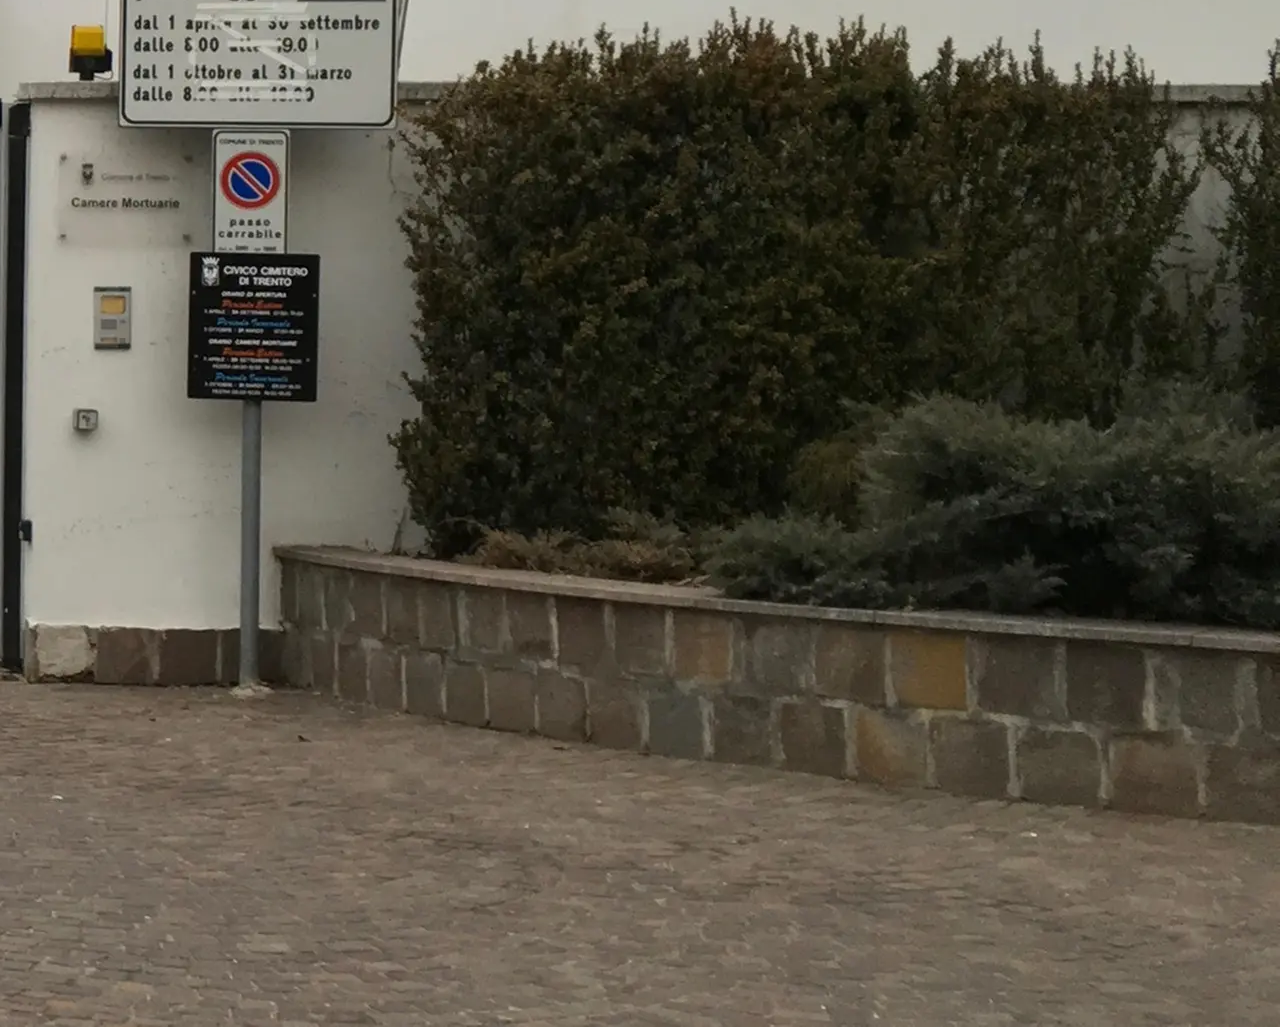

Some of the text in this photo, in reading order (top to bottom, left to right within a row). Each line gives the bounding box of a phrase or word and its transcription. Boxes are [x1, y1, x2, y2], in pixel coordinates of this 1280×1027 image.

[133, 15, 158, 30] dal
[169, 15, 175, 30] 1
[300, 15, 380, 30] settembre
[134, 37, 174, 52] dalle
[133, 64, 158, 80] dal
[168, 64, 174, 79] 1
[252, 64, 268, 79] al
[133, 86, 173, 101] dalle
[71, 197, 180, 208] Camere Mortuarie
[219, 230, 281, 239] carrabile
[223, 266, 309, 276] CIVICO CIMITERO
[239, 277, 292, 287] DI TRENTO
